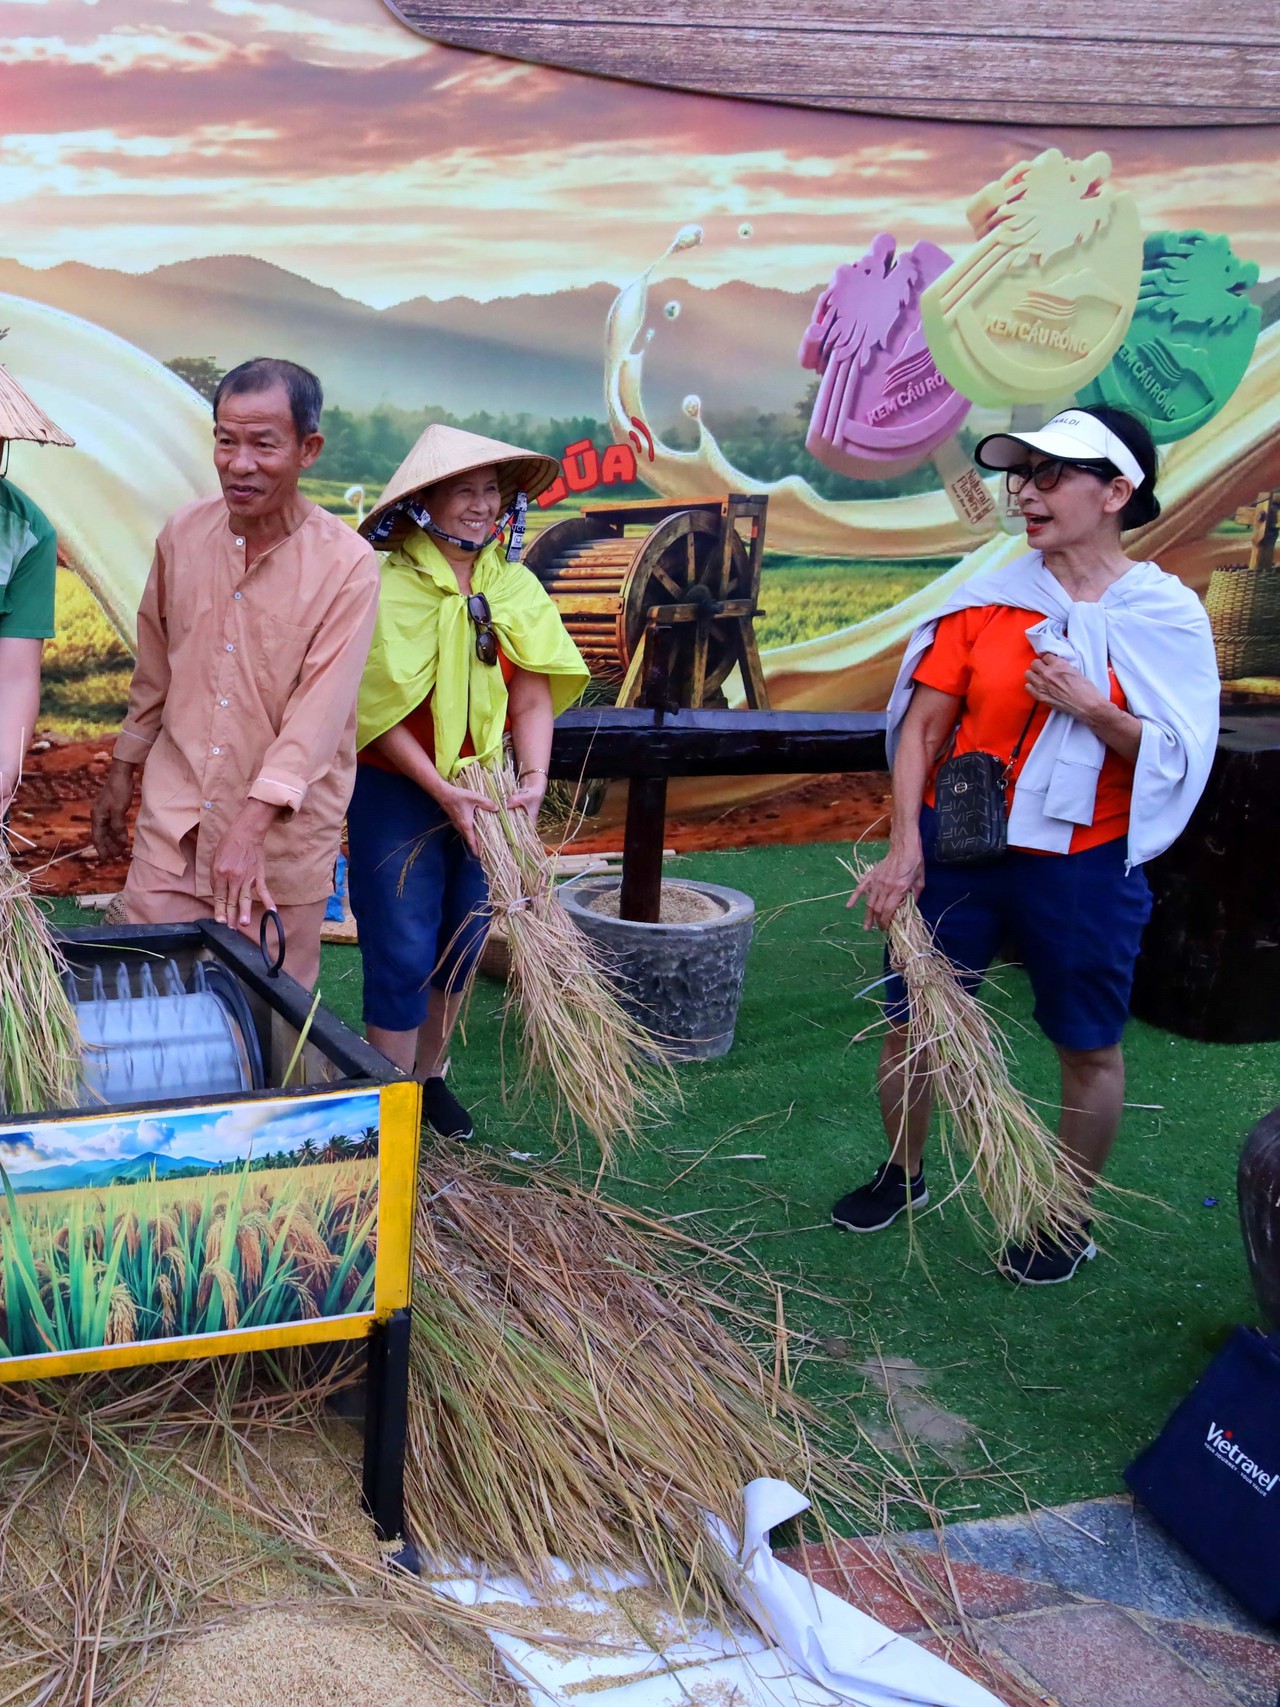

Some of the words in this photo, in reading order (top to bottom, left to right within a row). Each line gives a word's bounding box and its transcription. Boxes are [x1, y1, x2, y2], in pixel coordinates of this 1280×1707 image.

[984, 315, 1018, 338] KEM
[867, 401, 899, 425] KEM
[966, 468, 991, 506] Natural
[1206, 1421, 1279, 1491] Vietravel
[1214, 1452, 1238, 1471] JOURNEY
